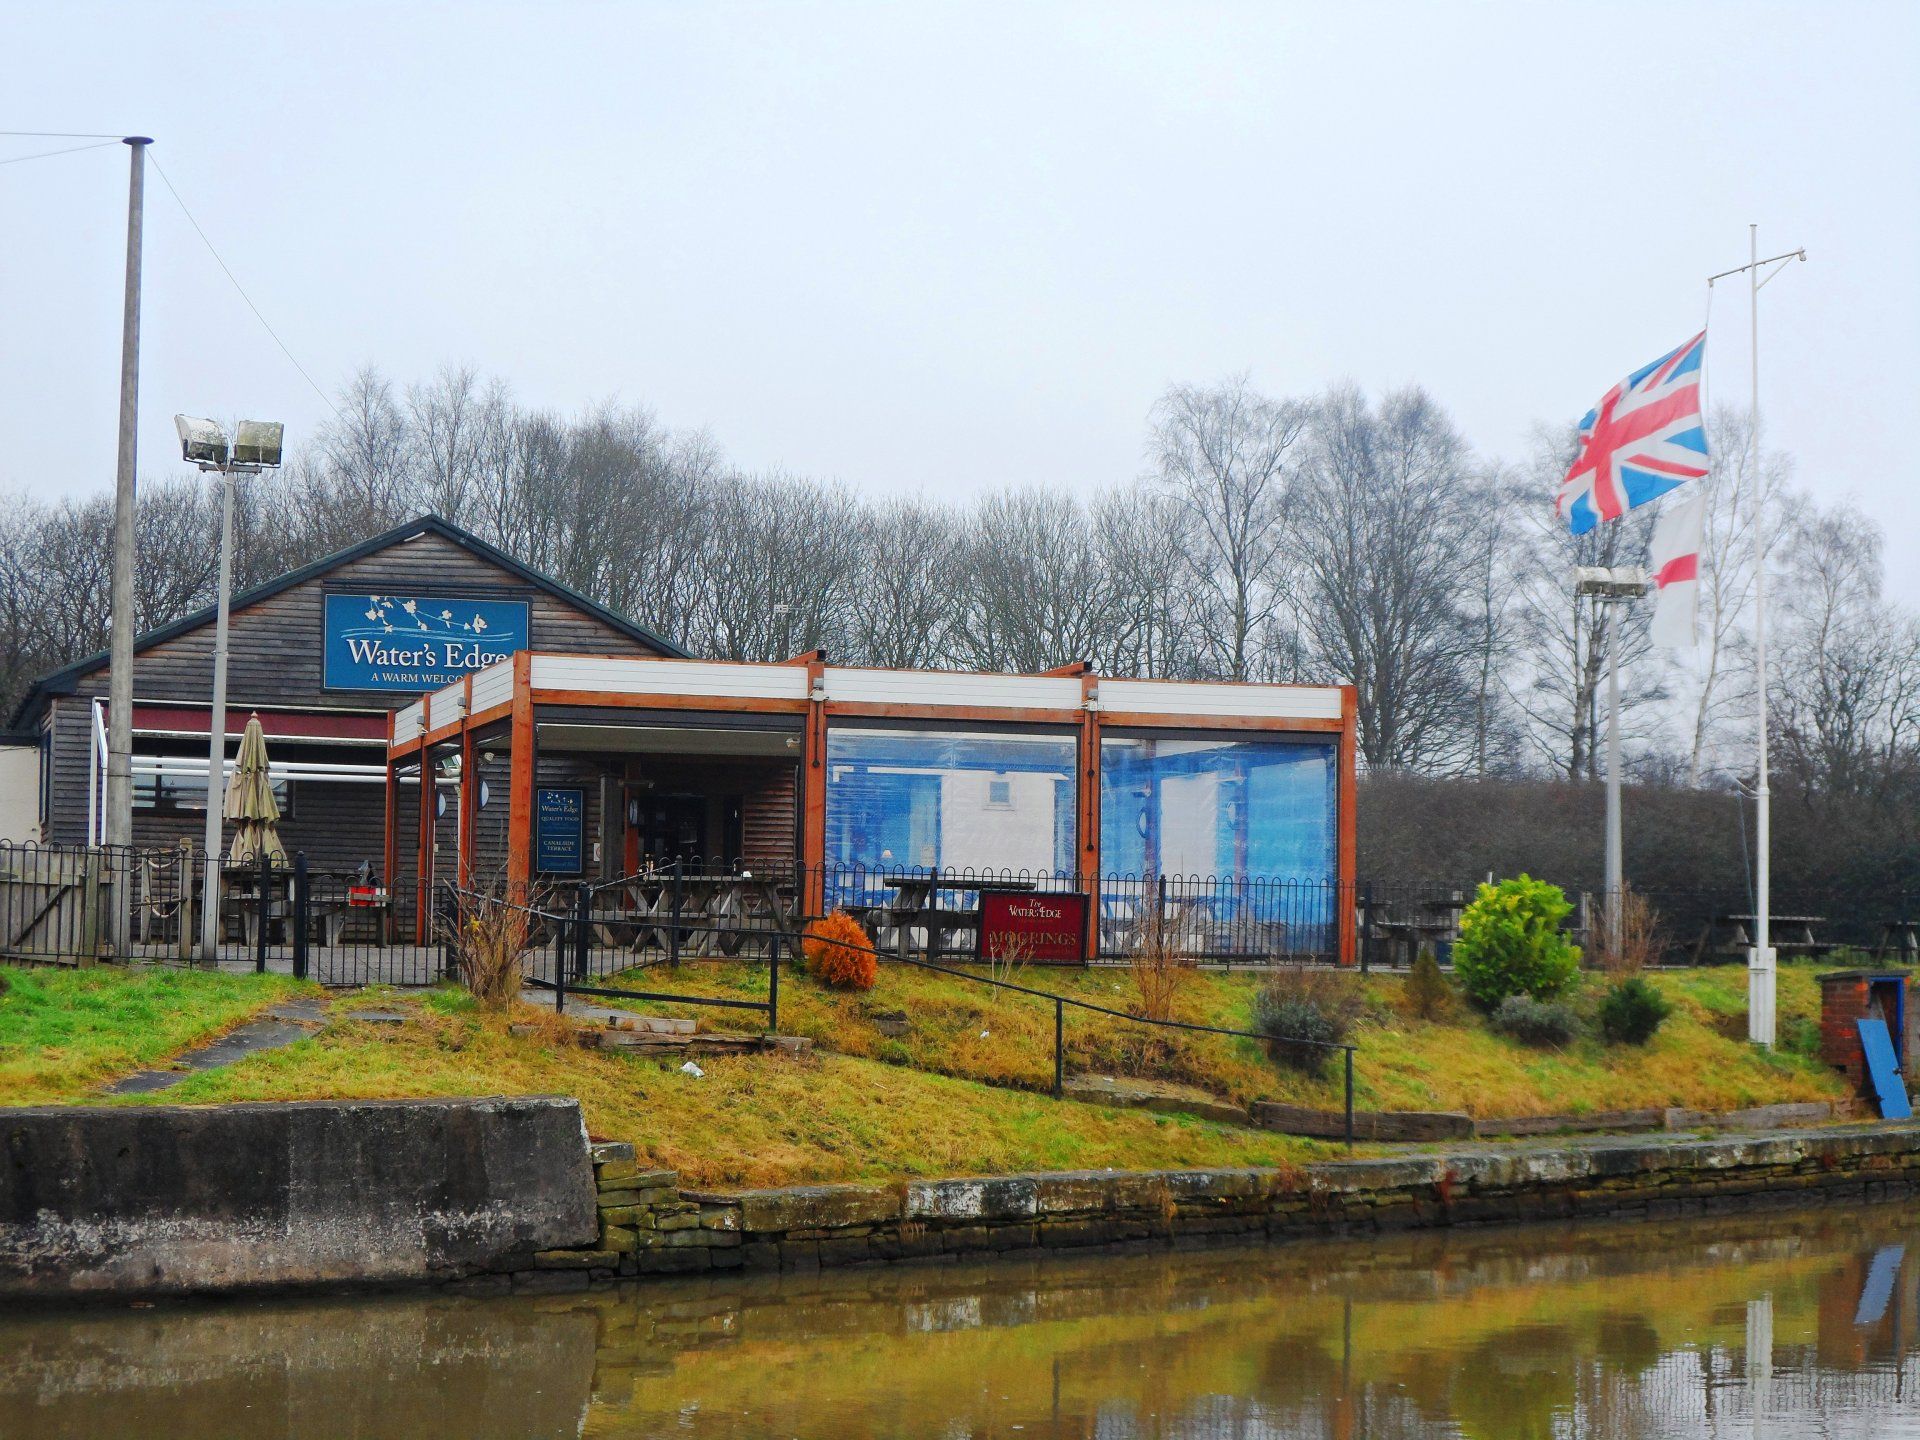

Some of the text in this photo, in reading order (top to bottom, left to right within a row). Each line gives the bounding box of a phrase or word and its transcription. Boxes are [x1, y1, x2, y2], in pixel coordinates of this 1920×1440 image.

[346, 639, 507, 670] Water's Edge
[371, 673, 464, 684] A WARM WELCO
[990, 930, 1076, 946] MOORINGS
